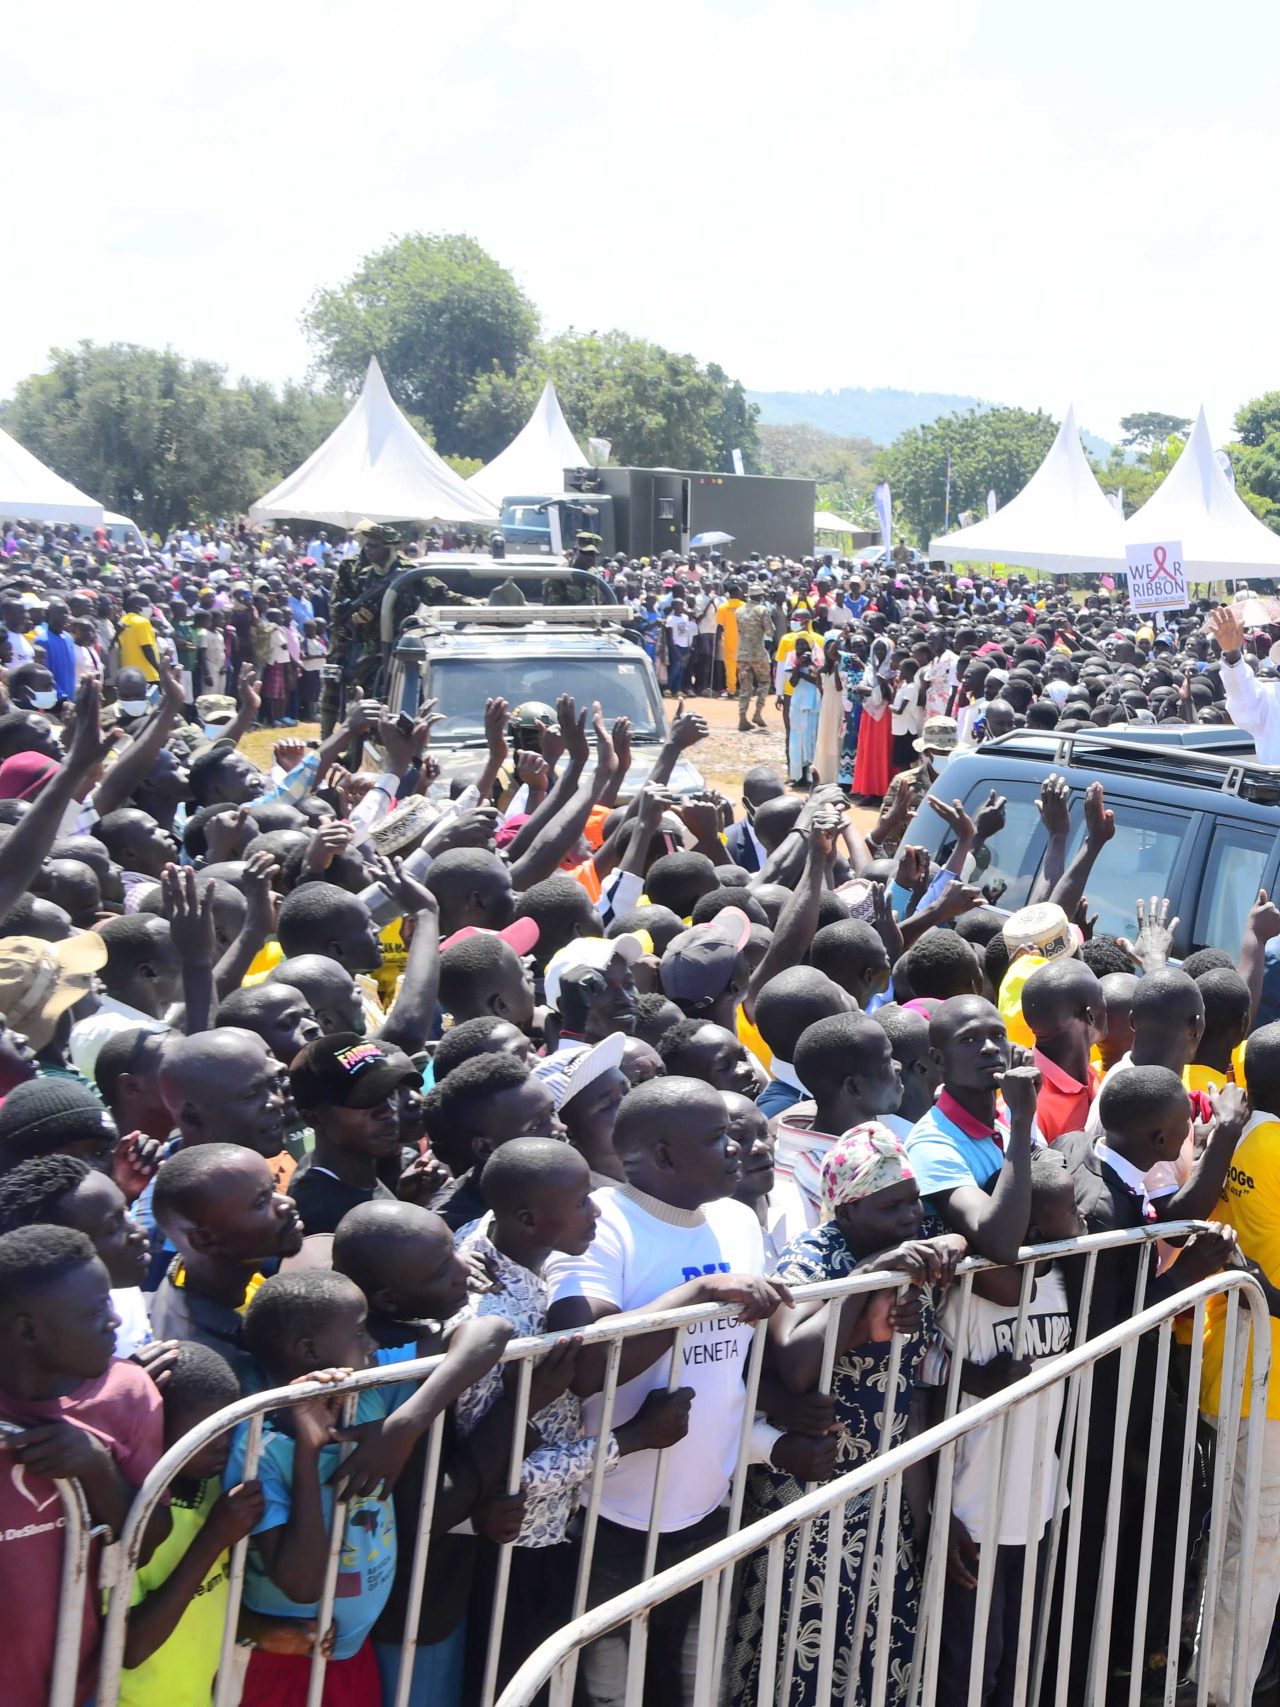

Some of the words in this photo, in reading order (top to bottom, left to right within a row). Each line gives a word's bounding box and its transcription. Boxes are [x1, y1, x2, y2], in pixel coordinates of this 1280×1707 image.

[1133, 580, 1185, 598] RIBBON
[683, 1339, 738, 1366] VENETA
[5, 1522, 55, 1540] DeShon
